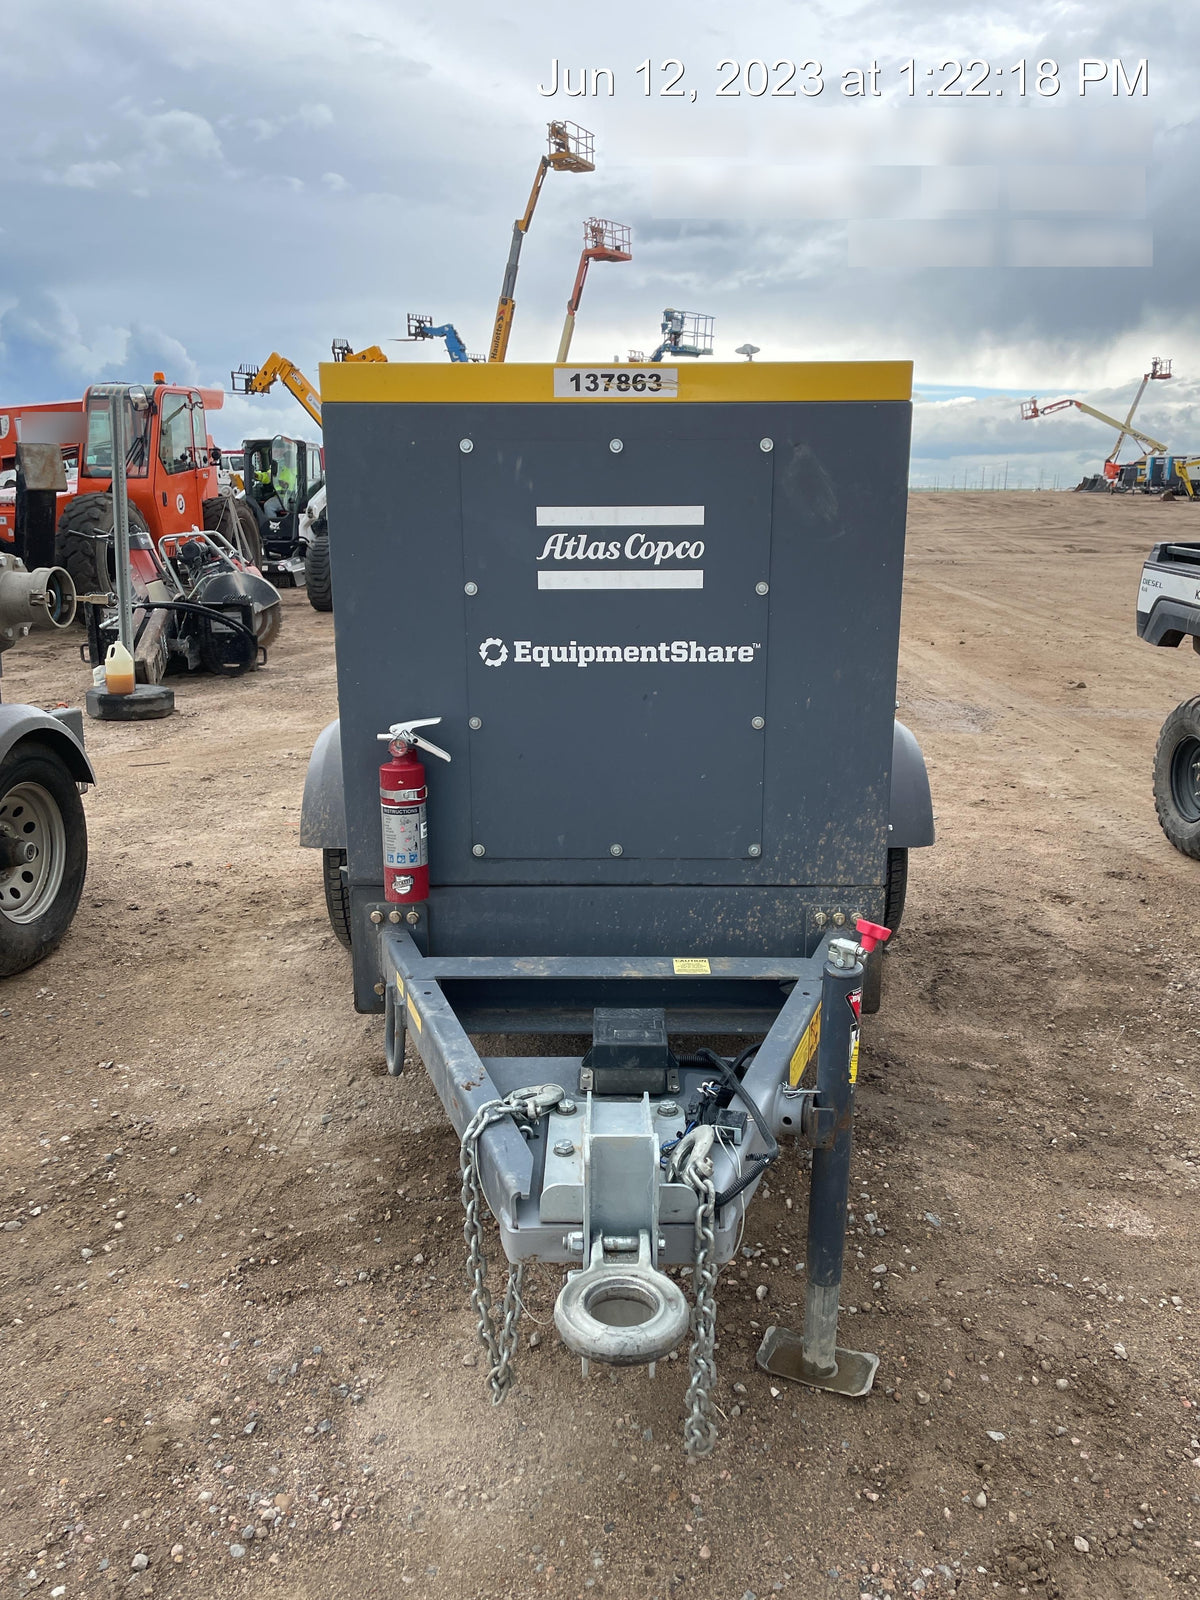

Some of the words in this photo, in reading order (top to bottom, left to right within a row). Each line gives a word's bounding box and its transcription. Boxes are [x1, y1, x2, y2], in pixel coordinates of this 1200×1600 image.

[490, 323, 503, 360] Haulotte
[569, 373, 663, 393] 137863
[536, 532, 621, 561] Atlas
[624, 532, 705, 565] Copco
[1142, 578, 1163, 589] DIESEL
[513, 640, 754, 667] EquipmentShare
[383, 807, 418, 815] INSTRUCTIONS
